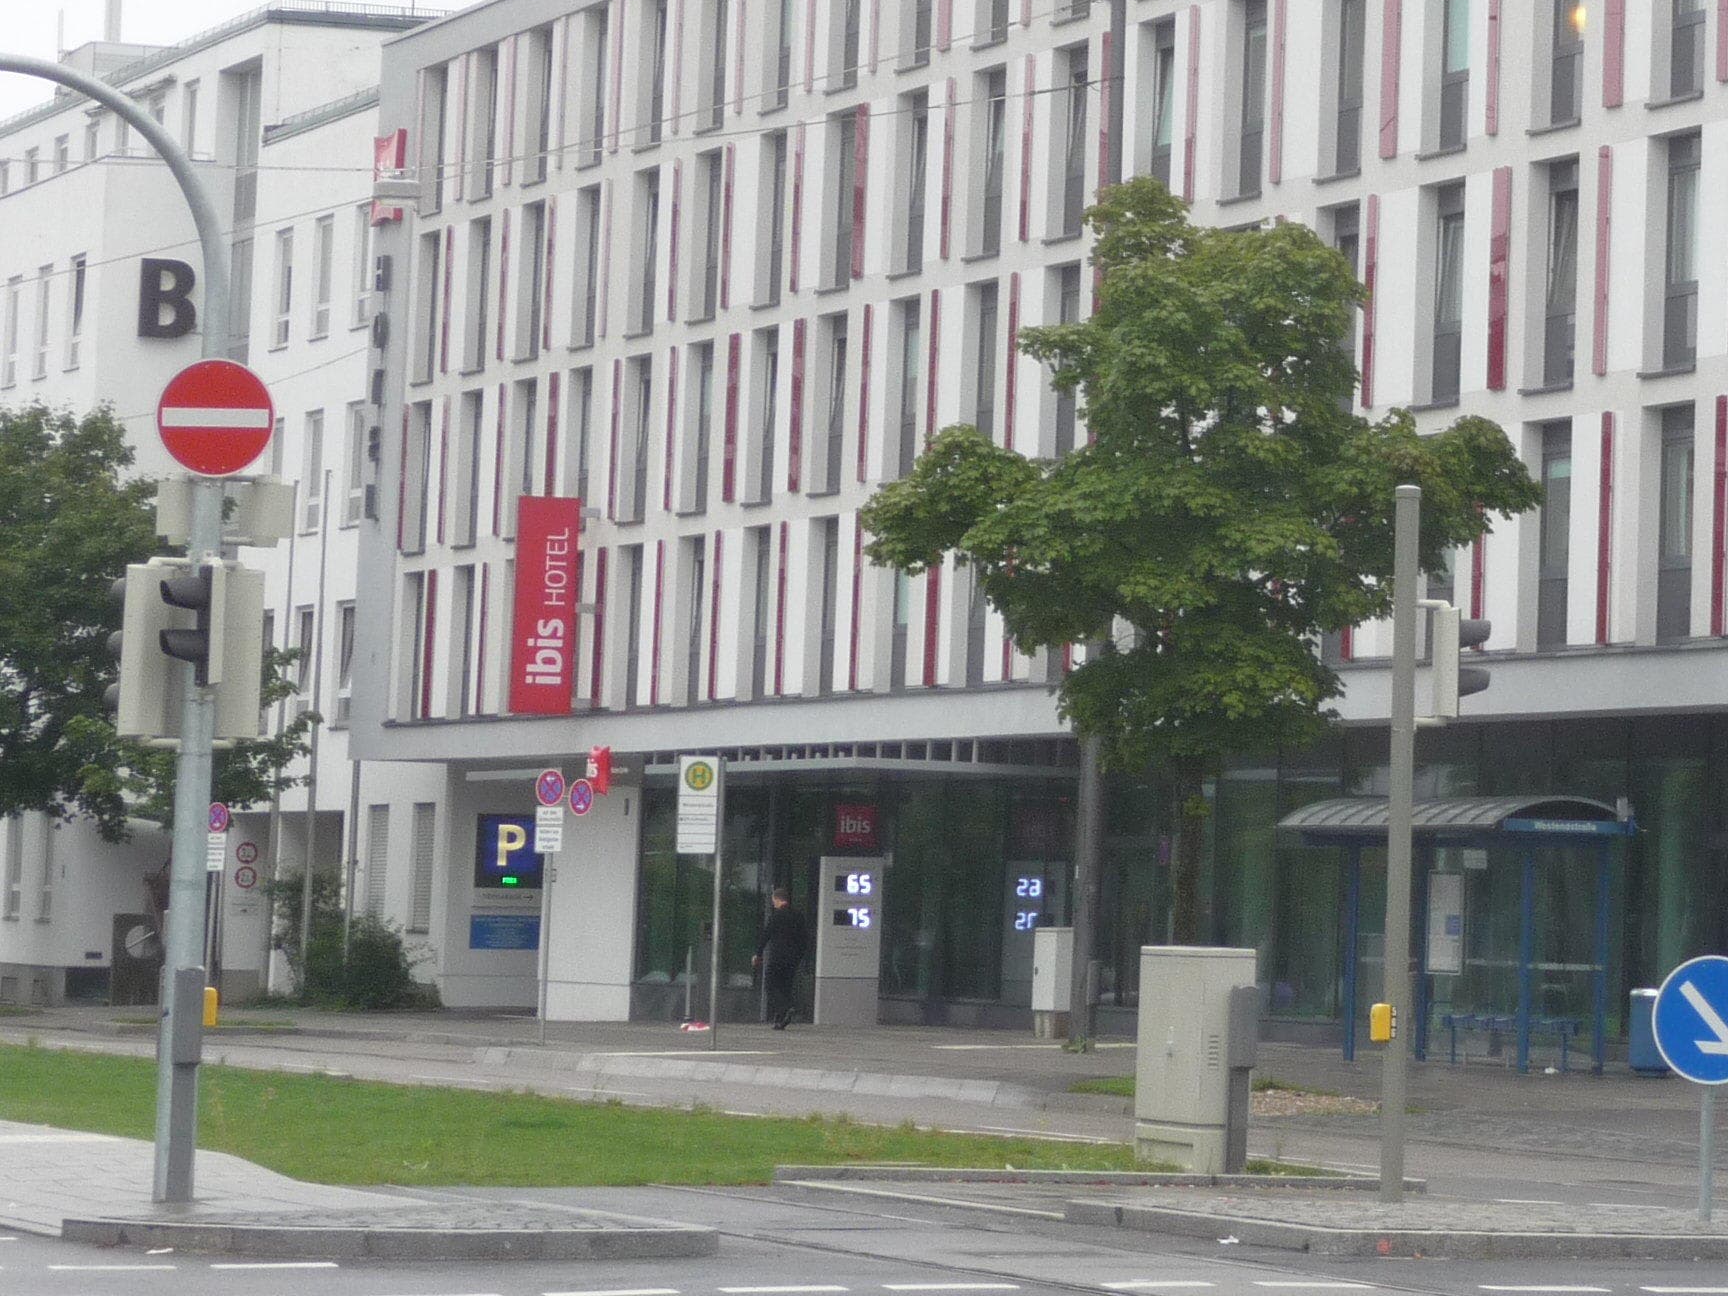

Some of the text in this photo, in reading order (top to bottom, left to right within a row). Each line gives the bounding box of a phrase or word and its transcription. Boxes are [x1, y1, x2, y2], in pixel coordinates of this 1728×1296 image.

[137, 257, 197, 339] B
[525, 527, 570, 686] ibis HOTEL
[839, 816, 872, 834] ibis
[496, 824, 526, 866] P
[846, 874, 871, 894] 65
[847, 908, 871, 928] 75
